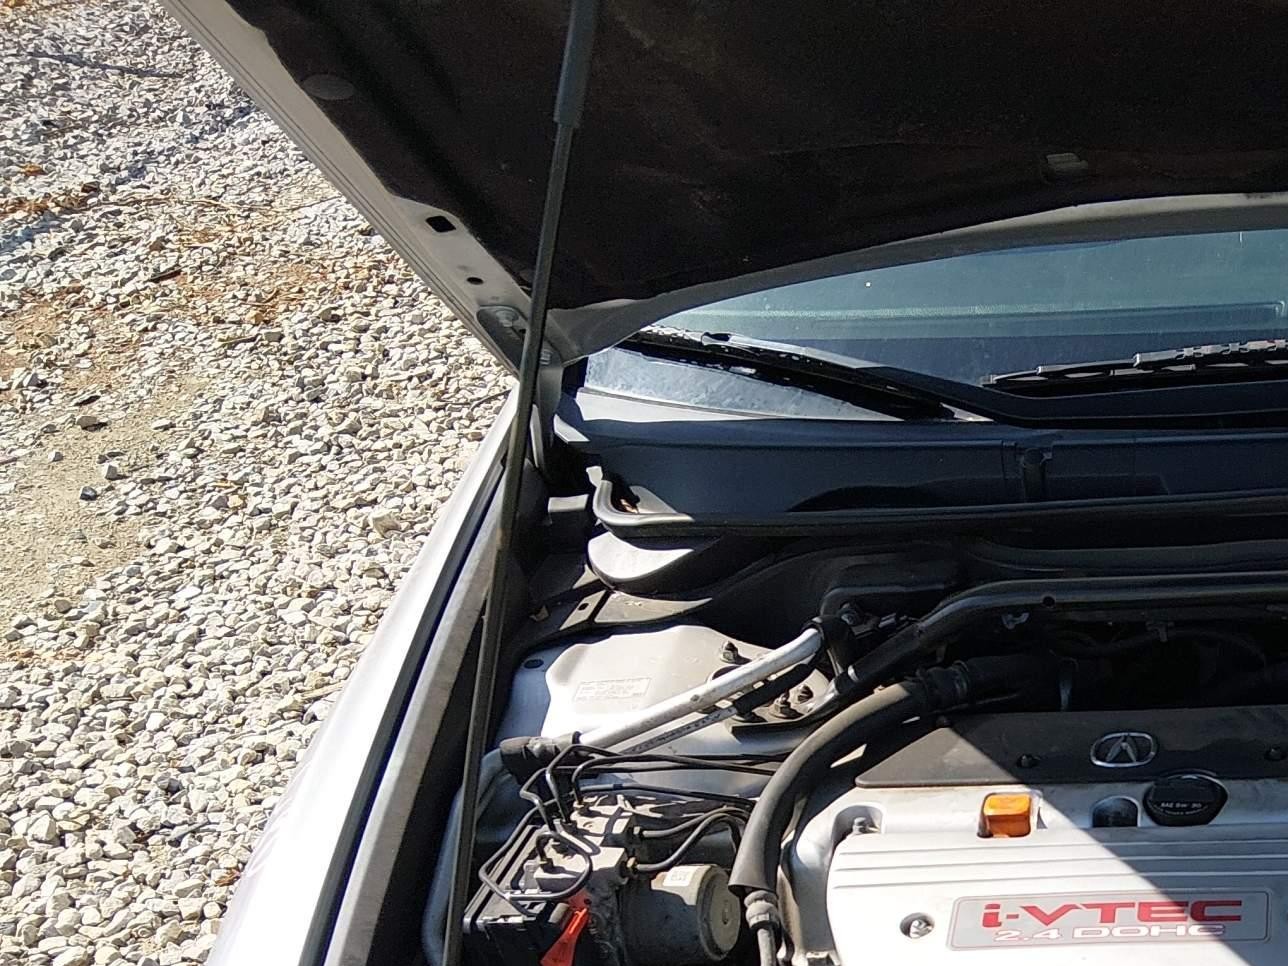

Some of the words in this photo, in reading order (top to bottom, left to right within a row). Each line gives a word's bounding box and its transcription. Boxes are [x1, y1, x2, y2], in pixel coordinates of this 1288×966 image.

[982, 900, 1242, 929] i-VTEC
[992, 927, 1062, 943] 2.4
[1072, 923, 1226, 940] DOHC
